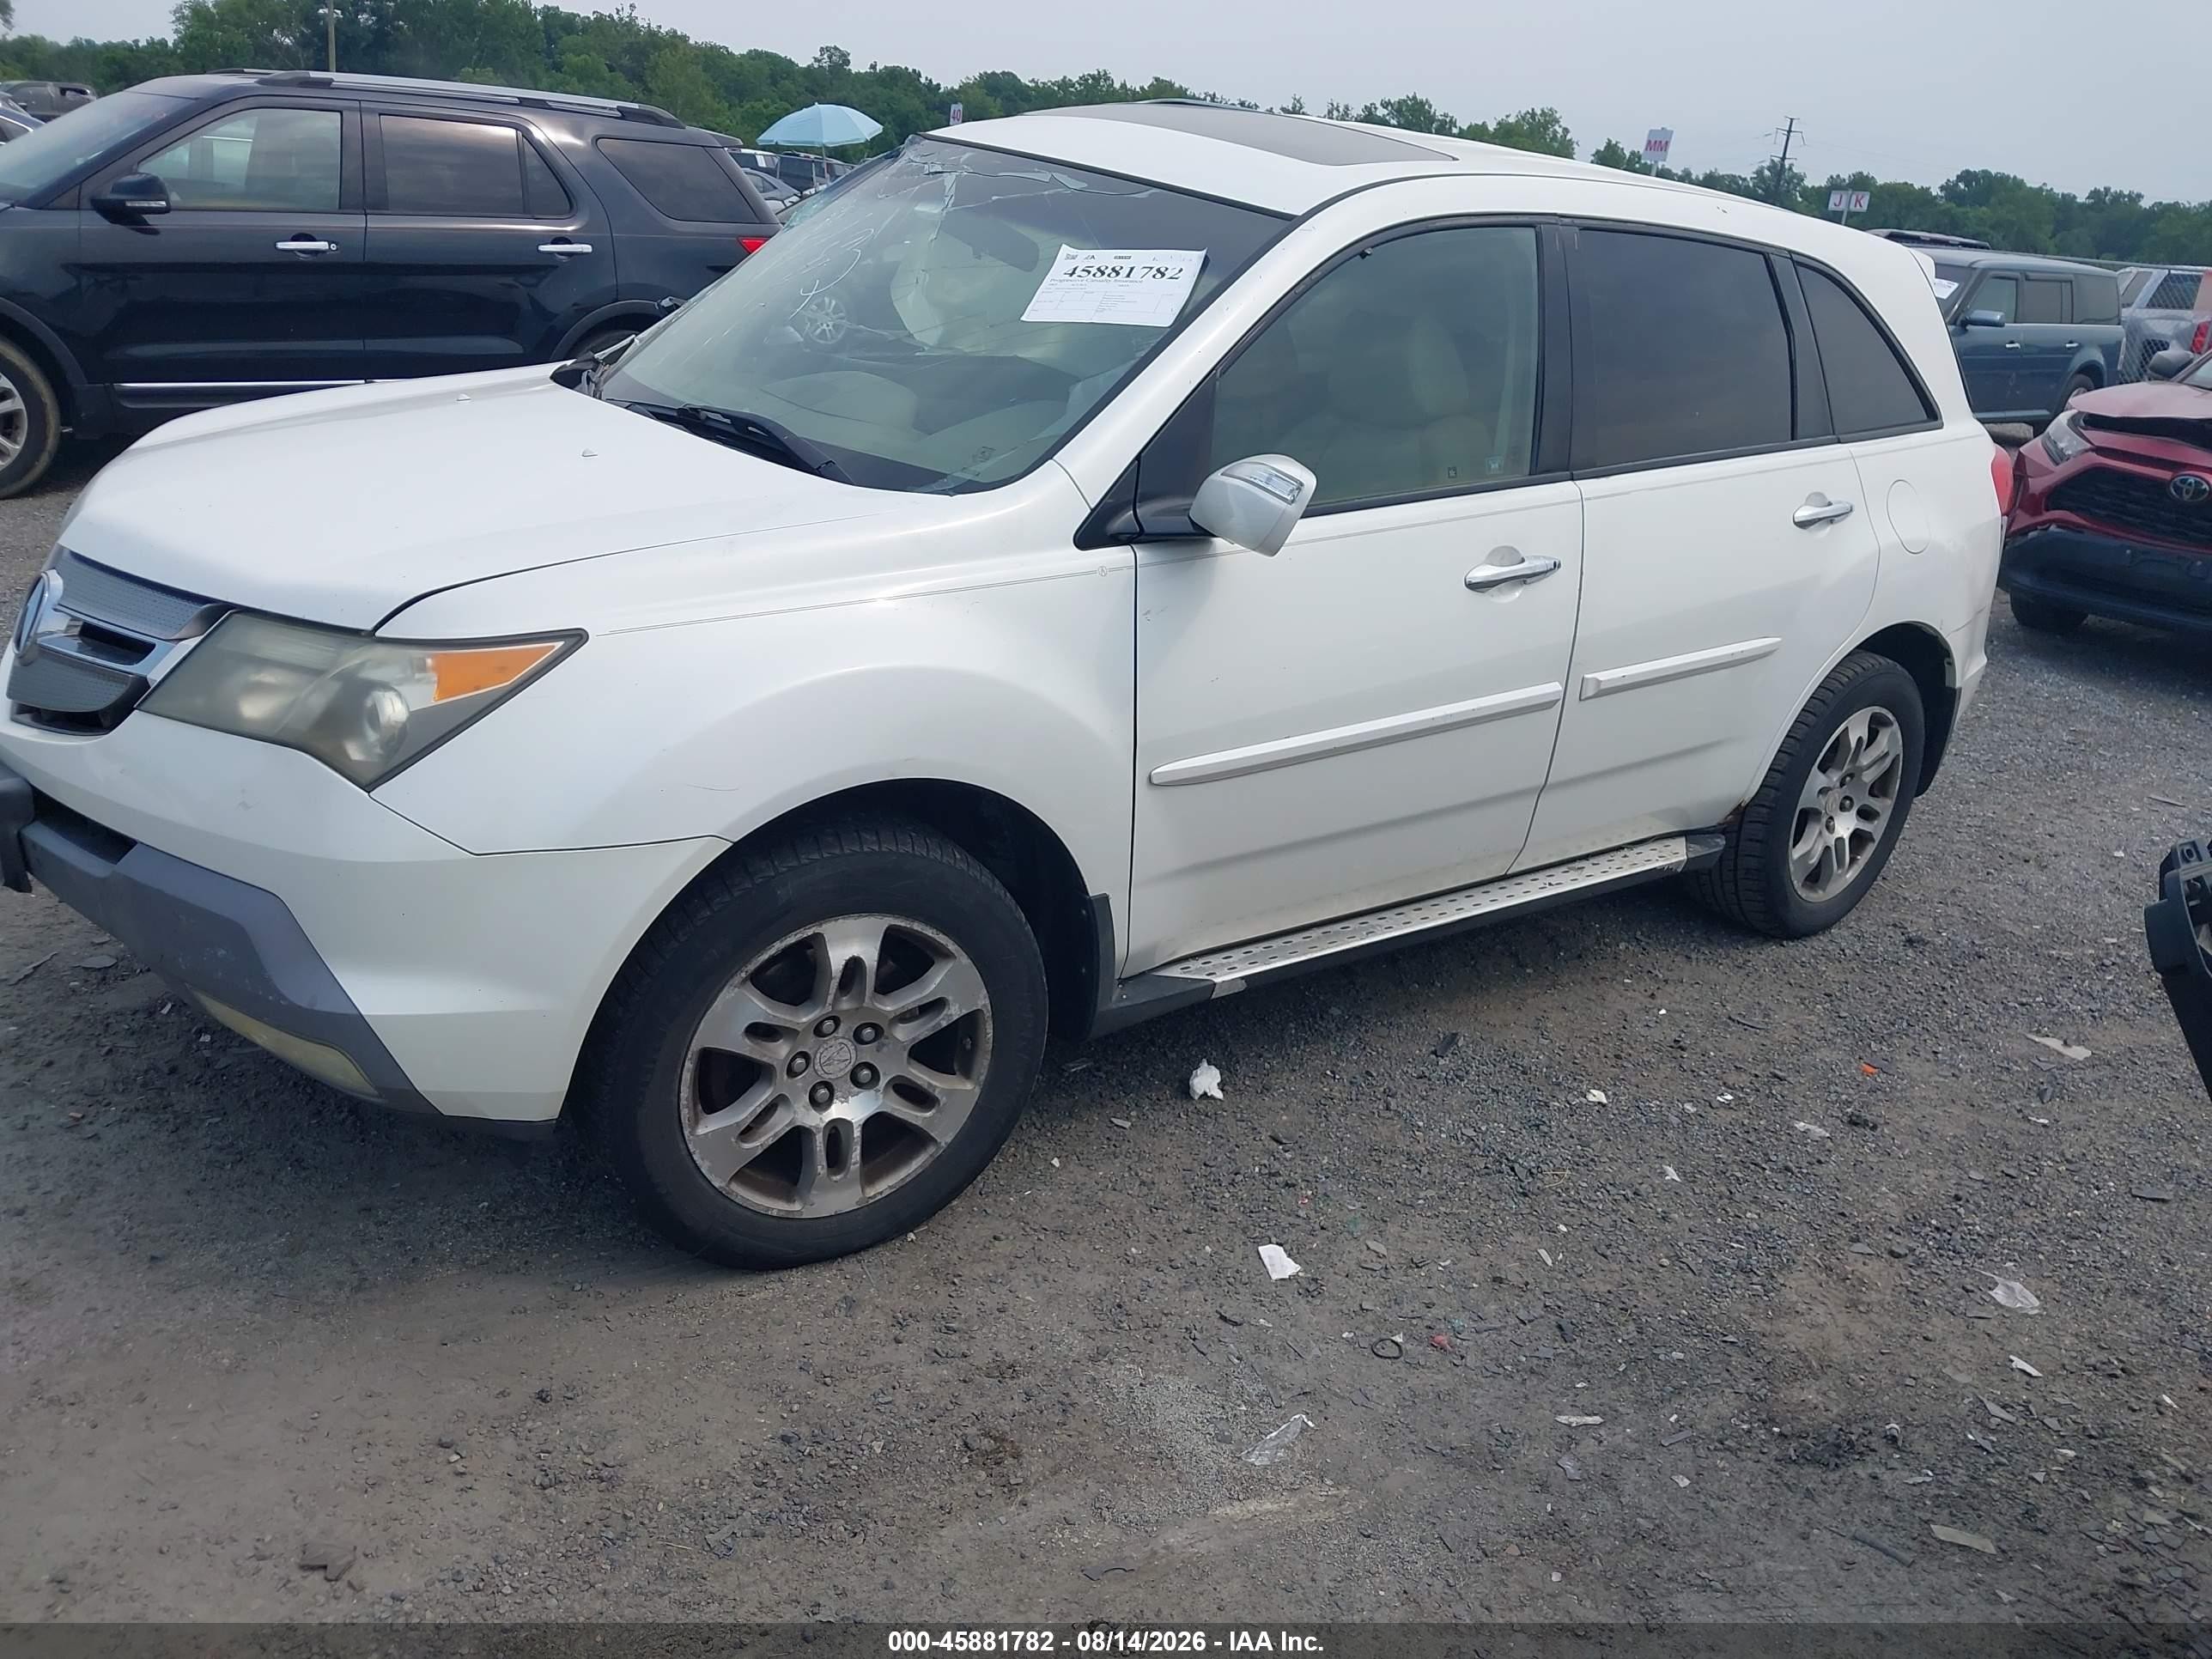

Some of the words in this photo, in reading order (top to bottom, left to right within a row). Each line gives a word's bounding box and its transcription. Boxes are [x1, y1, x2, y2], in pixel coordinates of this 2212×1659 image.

[951, 110, 961, 121] 40
[1644, 140, 1668, 151] MM
[1833, 193, 1843, 207] J
[1854, 194, 1863, 208] K
[1063, 264, 1184, 280] 45881782
